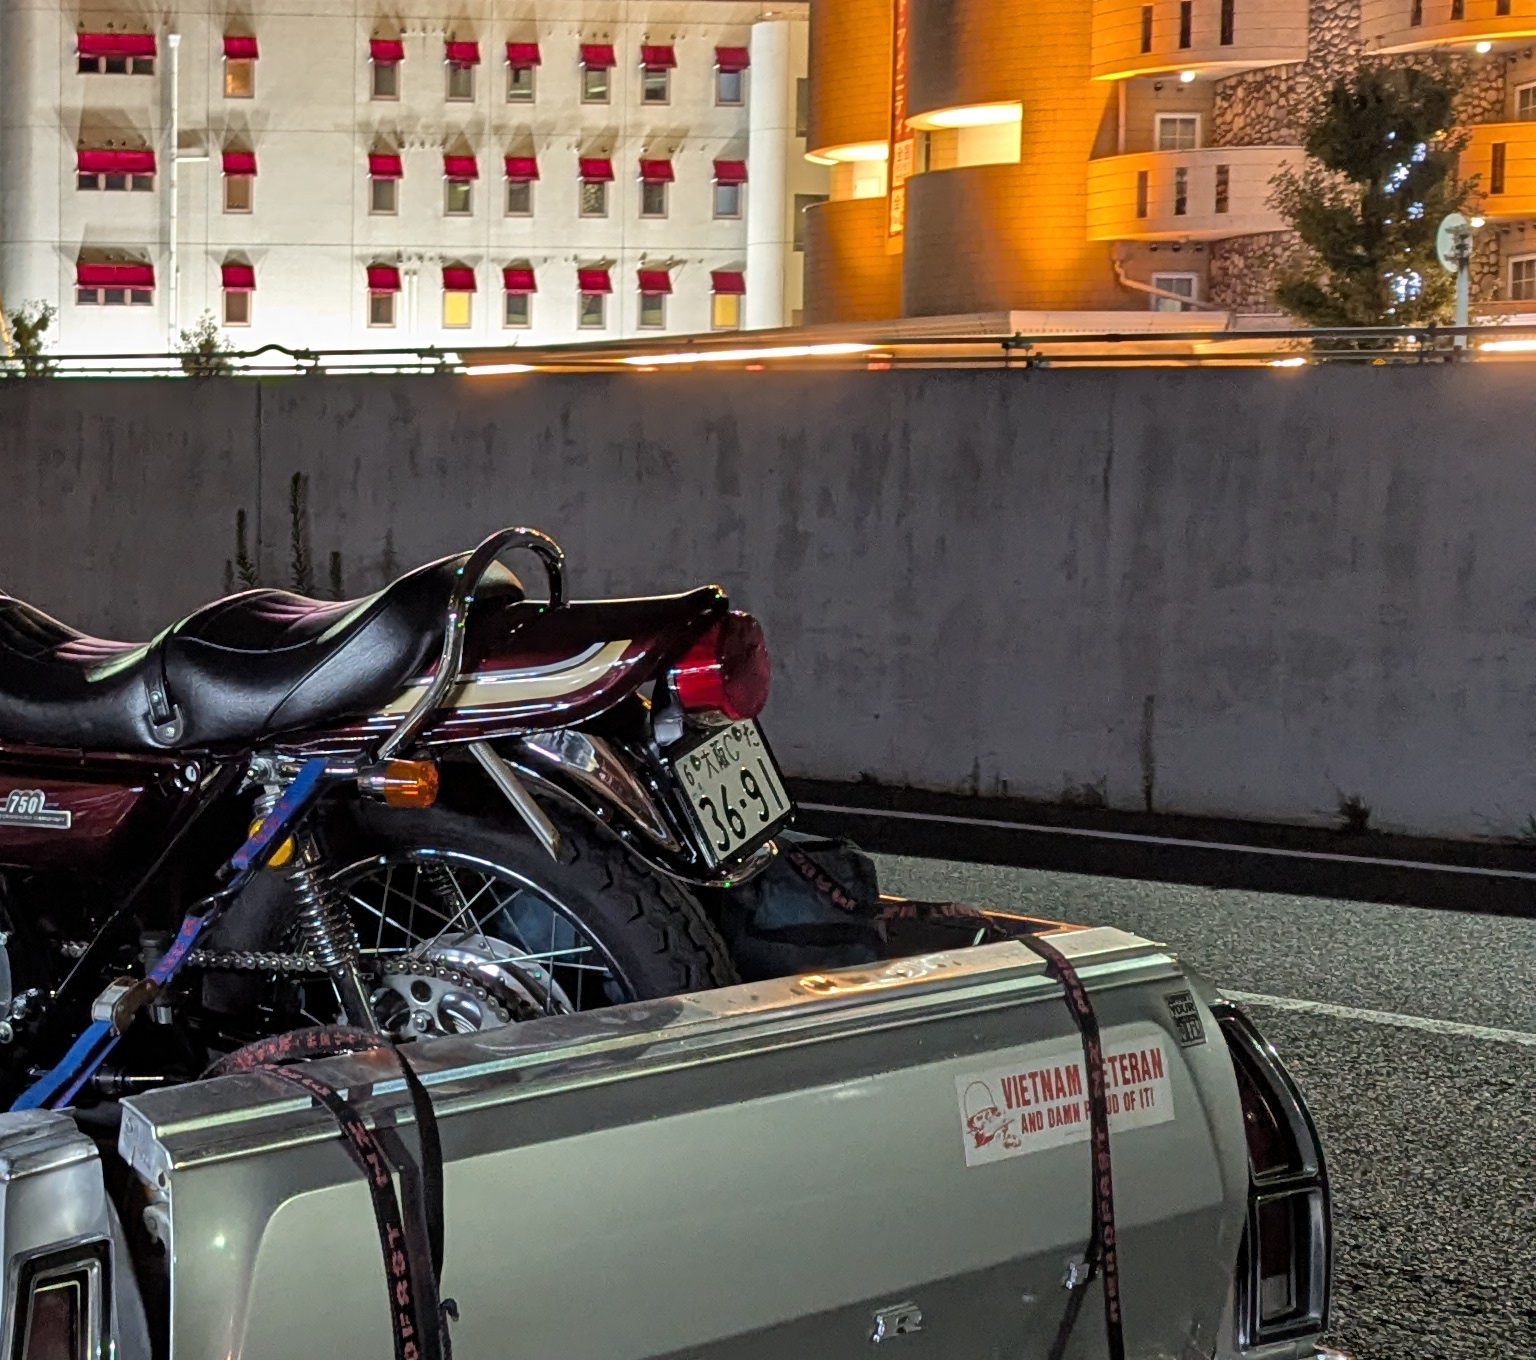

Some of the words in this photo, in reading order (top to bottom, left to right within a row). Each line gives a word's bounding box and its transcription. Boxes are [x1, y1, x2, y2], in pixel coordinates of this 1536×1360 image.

[8, 795, 39, 814] 750
[1000, 1064, 1083, 1110] VIETNAM
[1101, 1047, 1164, 1090] ETERAN
[1021, 1110, 1044, 1134] AND
[1047, 1102, 1081, 1129] DAMN
[1084, 1092, 1119, 1121] PUD
[1123, 1092, 1136, 1112] OF
[1140, 1086, 1155, 1109] IT!
